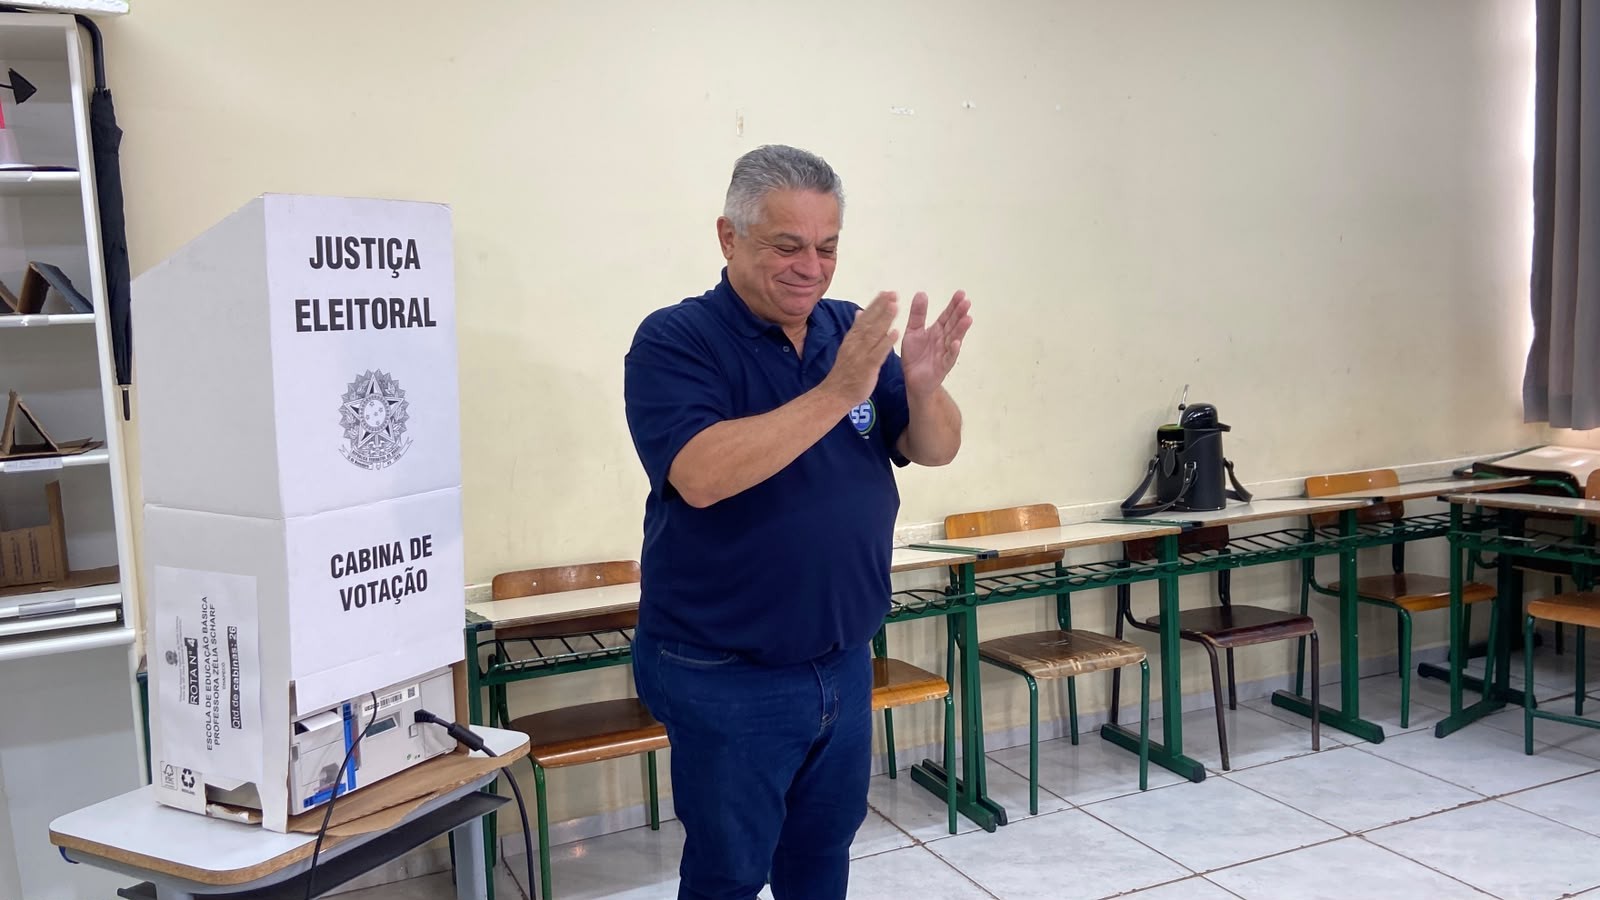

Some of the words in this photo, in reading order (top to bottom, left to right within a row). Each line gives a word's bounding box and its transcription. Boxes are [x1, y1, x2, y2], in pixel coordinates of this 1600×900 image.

[309, 236, 421, 278] JUSTIÇA
[295, 297, 437, 332] ELEITORAL
[330, 541, 404, 579] CABINA
[410, 534, 432, 561] DE
[339, 566, 428, 612] VOTAÇÃO
[228, 626, 237, 640] 26
[202, 636, 211, 692] EDUCAÇÃO
[211, 647, 219, 676] ZÉLIA
[189, 668, 199, 705] ROTA
[205, 694, 211, 708] DE
